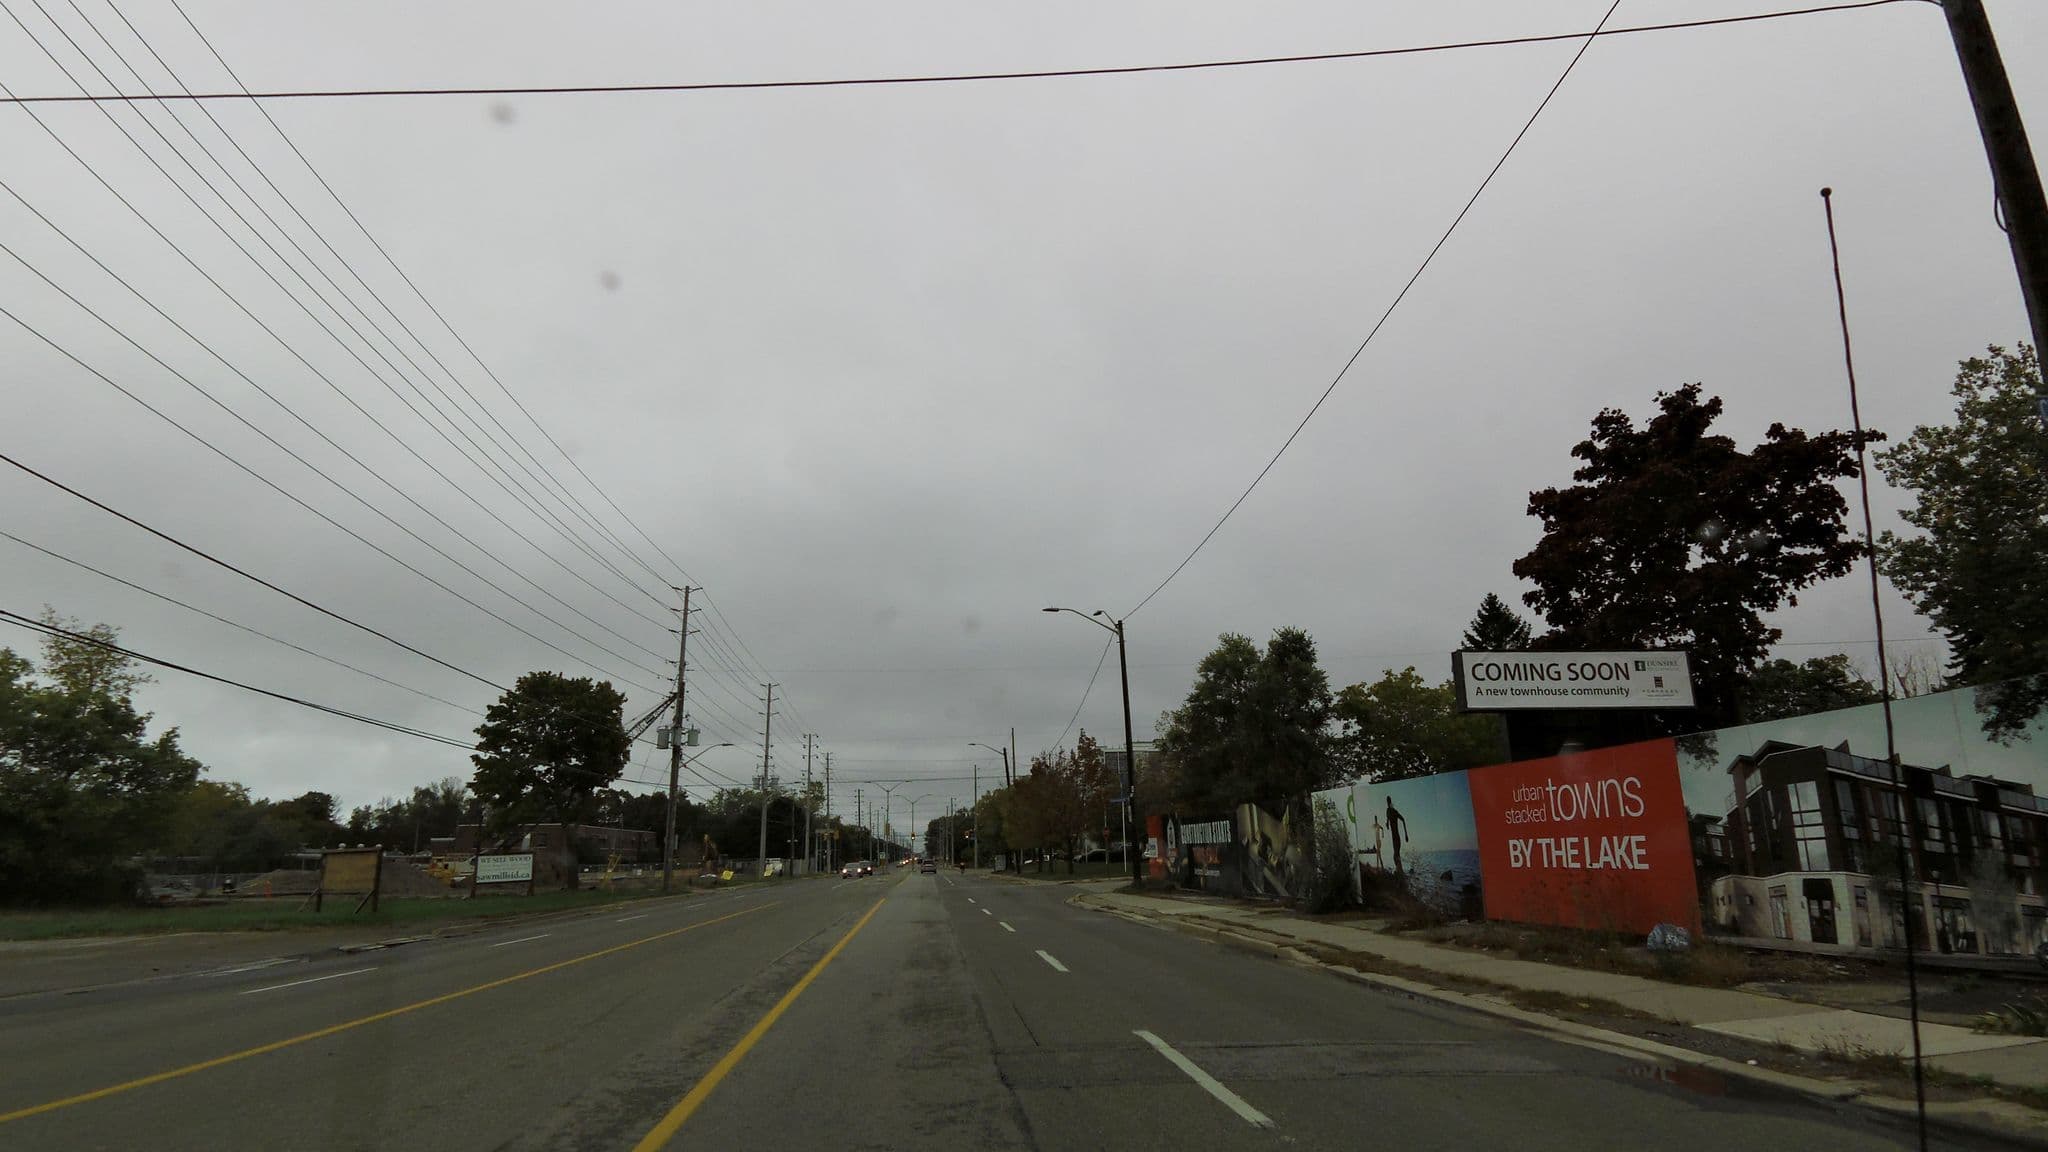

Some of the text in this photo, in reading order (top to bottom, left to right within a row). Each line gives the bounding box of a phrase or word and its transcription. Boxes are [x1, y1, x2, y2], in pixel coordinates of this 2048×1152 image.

[1471, 662, 1630, 681] COMING SOON
[1475, 686, 1630, 698] A new townhouse community
[1513, 777, 1645, 821] urban towns
[1505, 804, 1547, 825] stacked
[1509, 836, 1649, 870] BY THE LAKE
